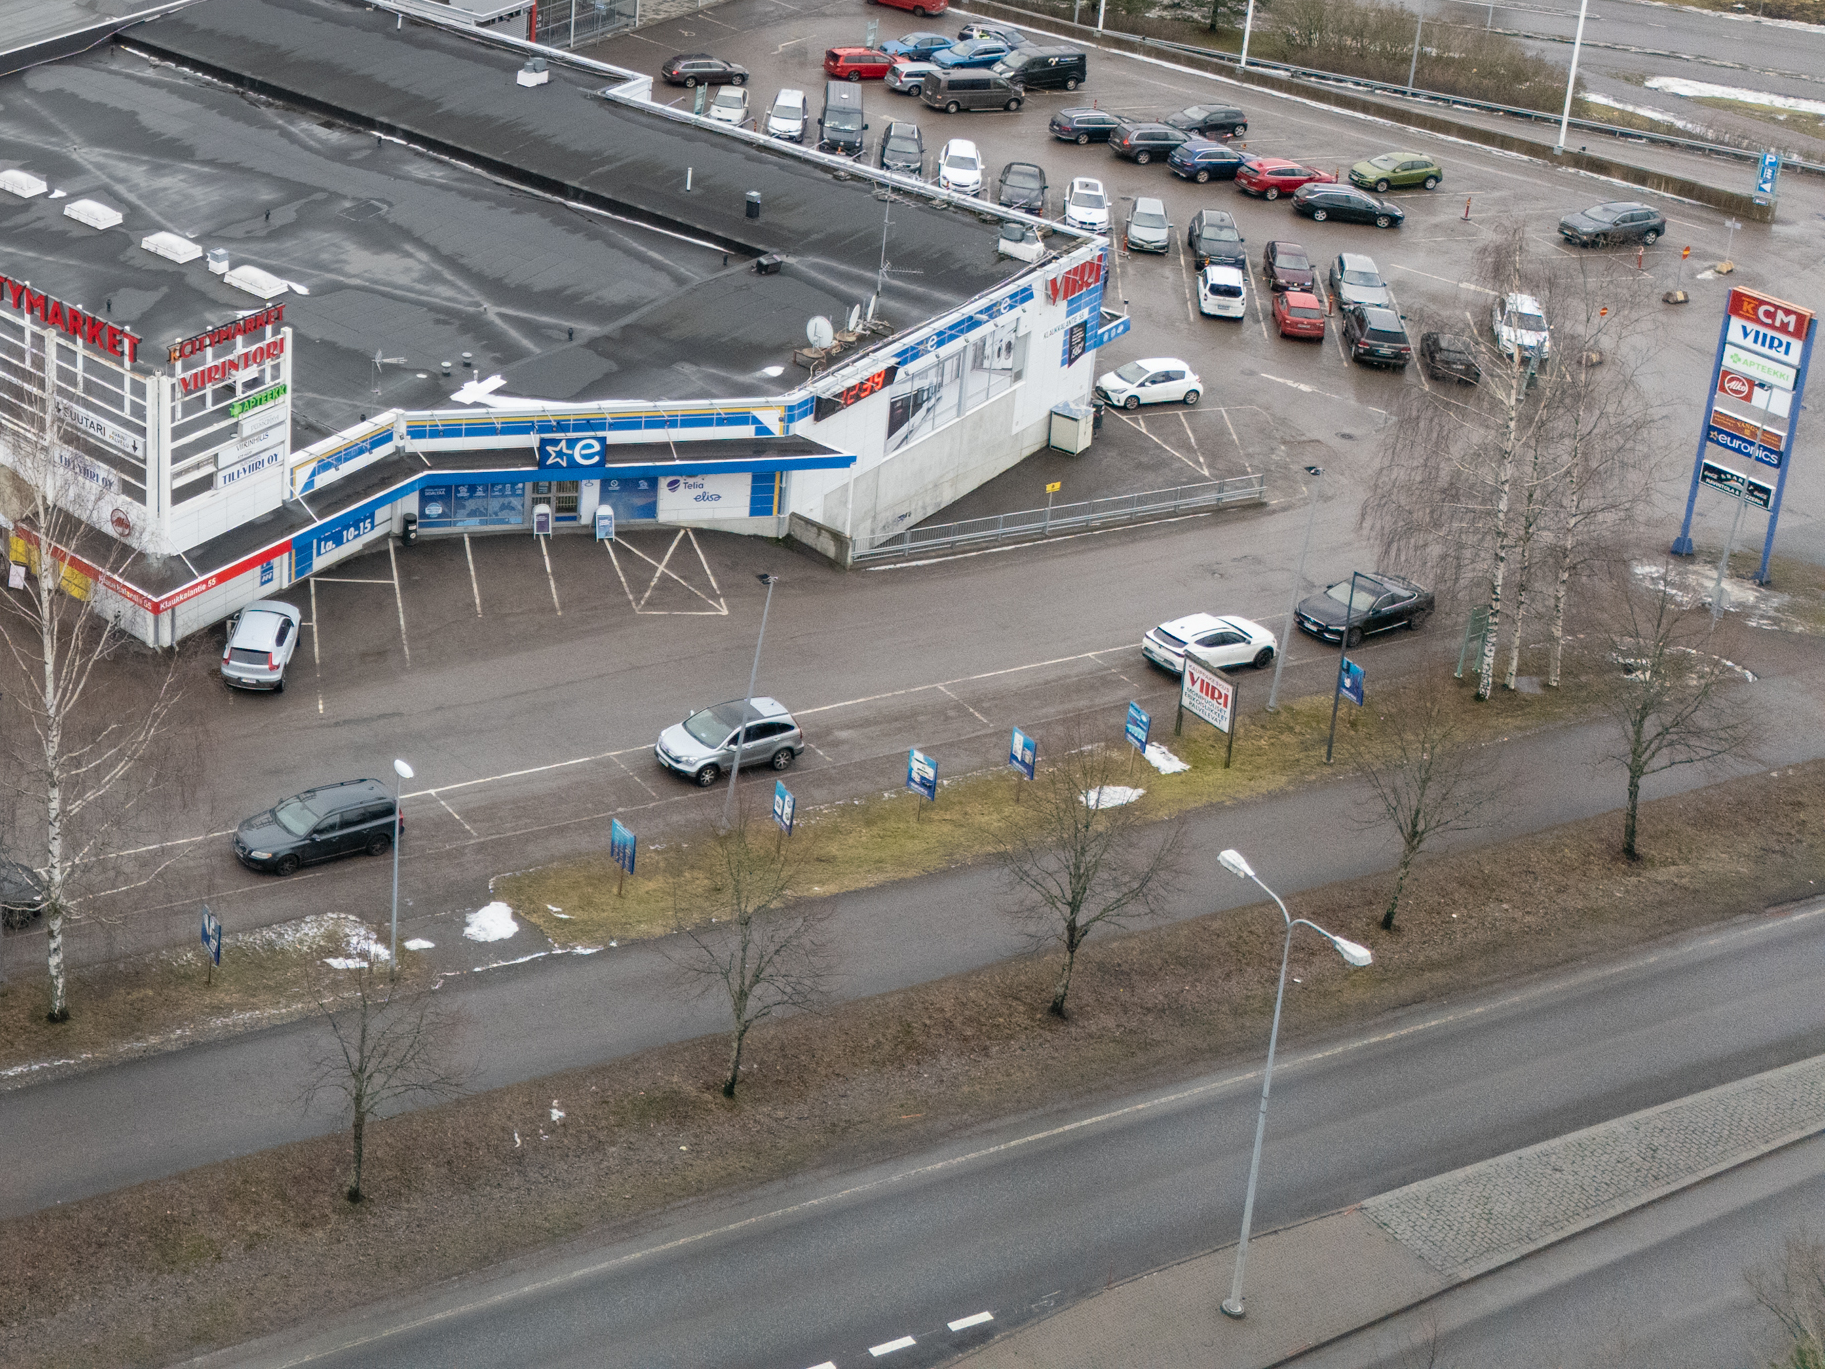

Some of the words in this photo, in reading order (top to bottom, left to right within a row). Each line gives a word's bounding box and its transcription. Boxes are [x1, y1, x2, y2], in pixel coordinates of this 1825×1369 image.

[1049, 253, 1103, 306] VIIRI
[180, 304, 286, 359] CITYMARKET
[1757, 304, 1796, 333] CM
[1741, 324, 1791, 356] VIIRI
[180, 337, 284, 393] VIIRINTORI
[1742, 358, 1790, 382] APTEEKKI
[62, 405, 106, 437] SUUTARI
[1718, 433, 1779, 464] euronics
[222, 458, 265, 485] TILI-VIIRI
[267, 453, 279, 465] OY
[683, 481, 704, 489] Telia
[693, 491, 722, 502] elisa
[320, 539, 336, 554] La.
[342, 519, 371, 543] 10-15
[160, 584, 206, 611] Klaukkalantie
[1188, 670, 1229, 710] VIIRI
[1189, 701, 1222, 725] PALVELEVAT
